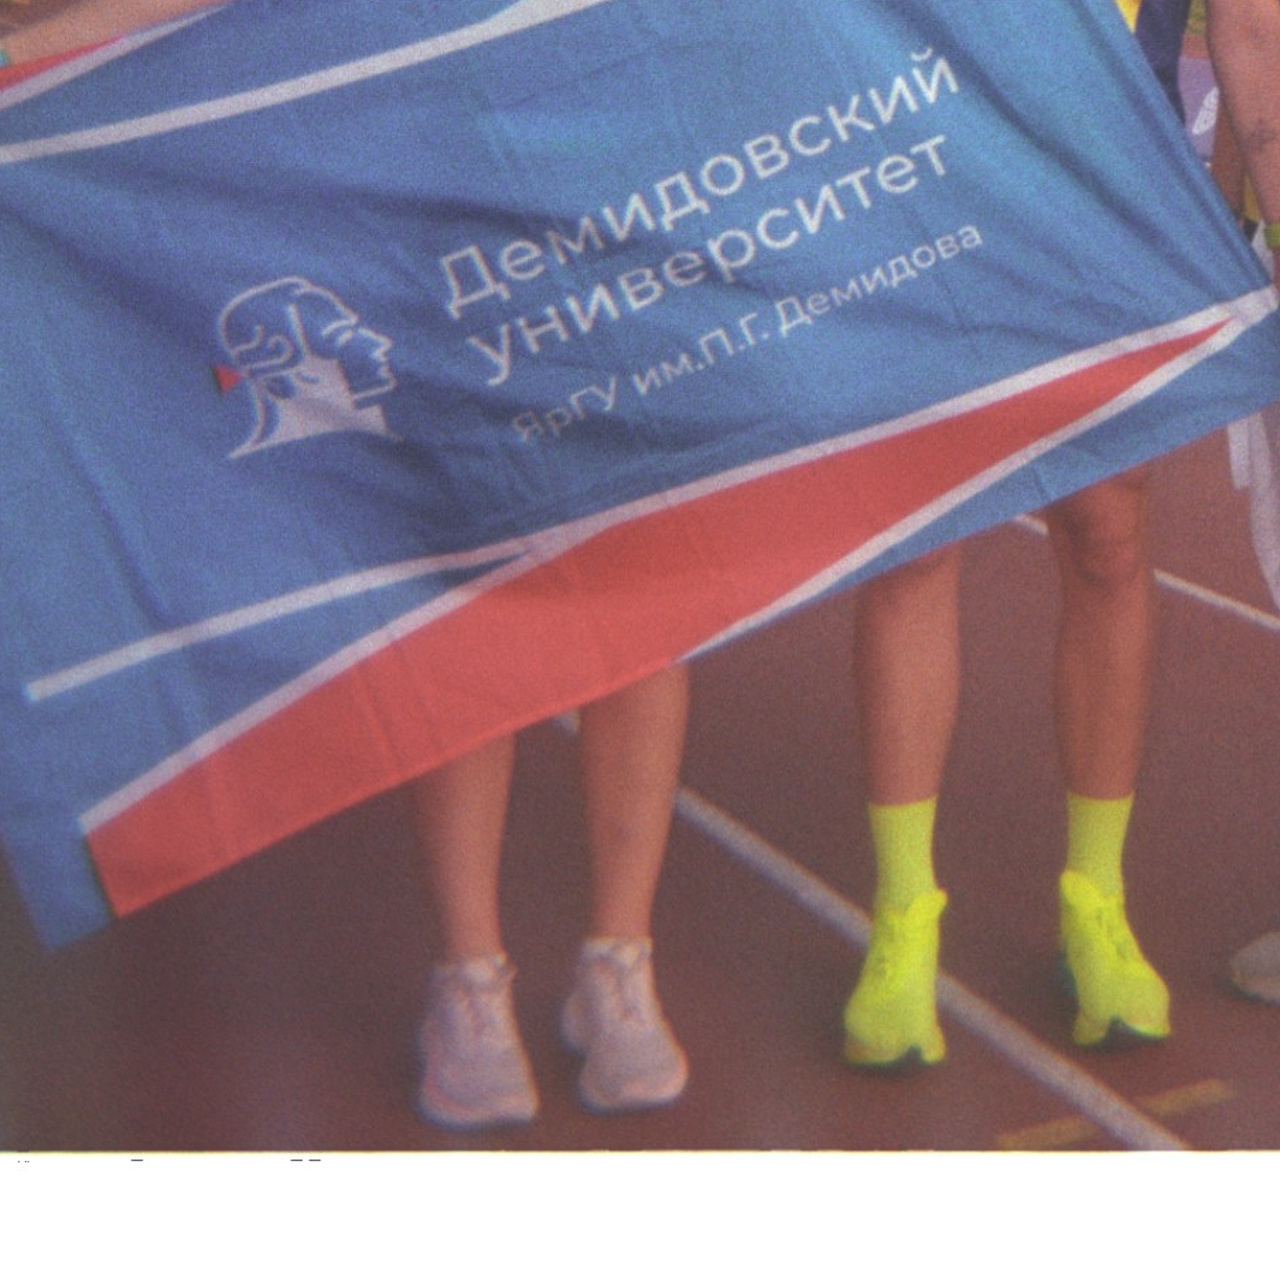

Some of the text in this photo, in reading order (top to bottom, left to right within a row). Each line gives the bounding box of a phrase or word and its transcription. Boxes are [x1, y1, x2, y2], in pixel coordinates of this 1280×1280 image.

[439, 47, 961, 319] Демидовский
[464, 134, 948, 387] университет
[774, 223, 984, 338] Демидова
